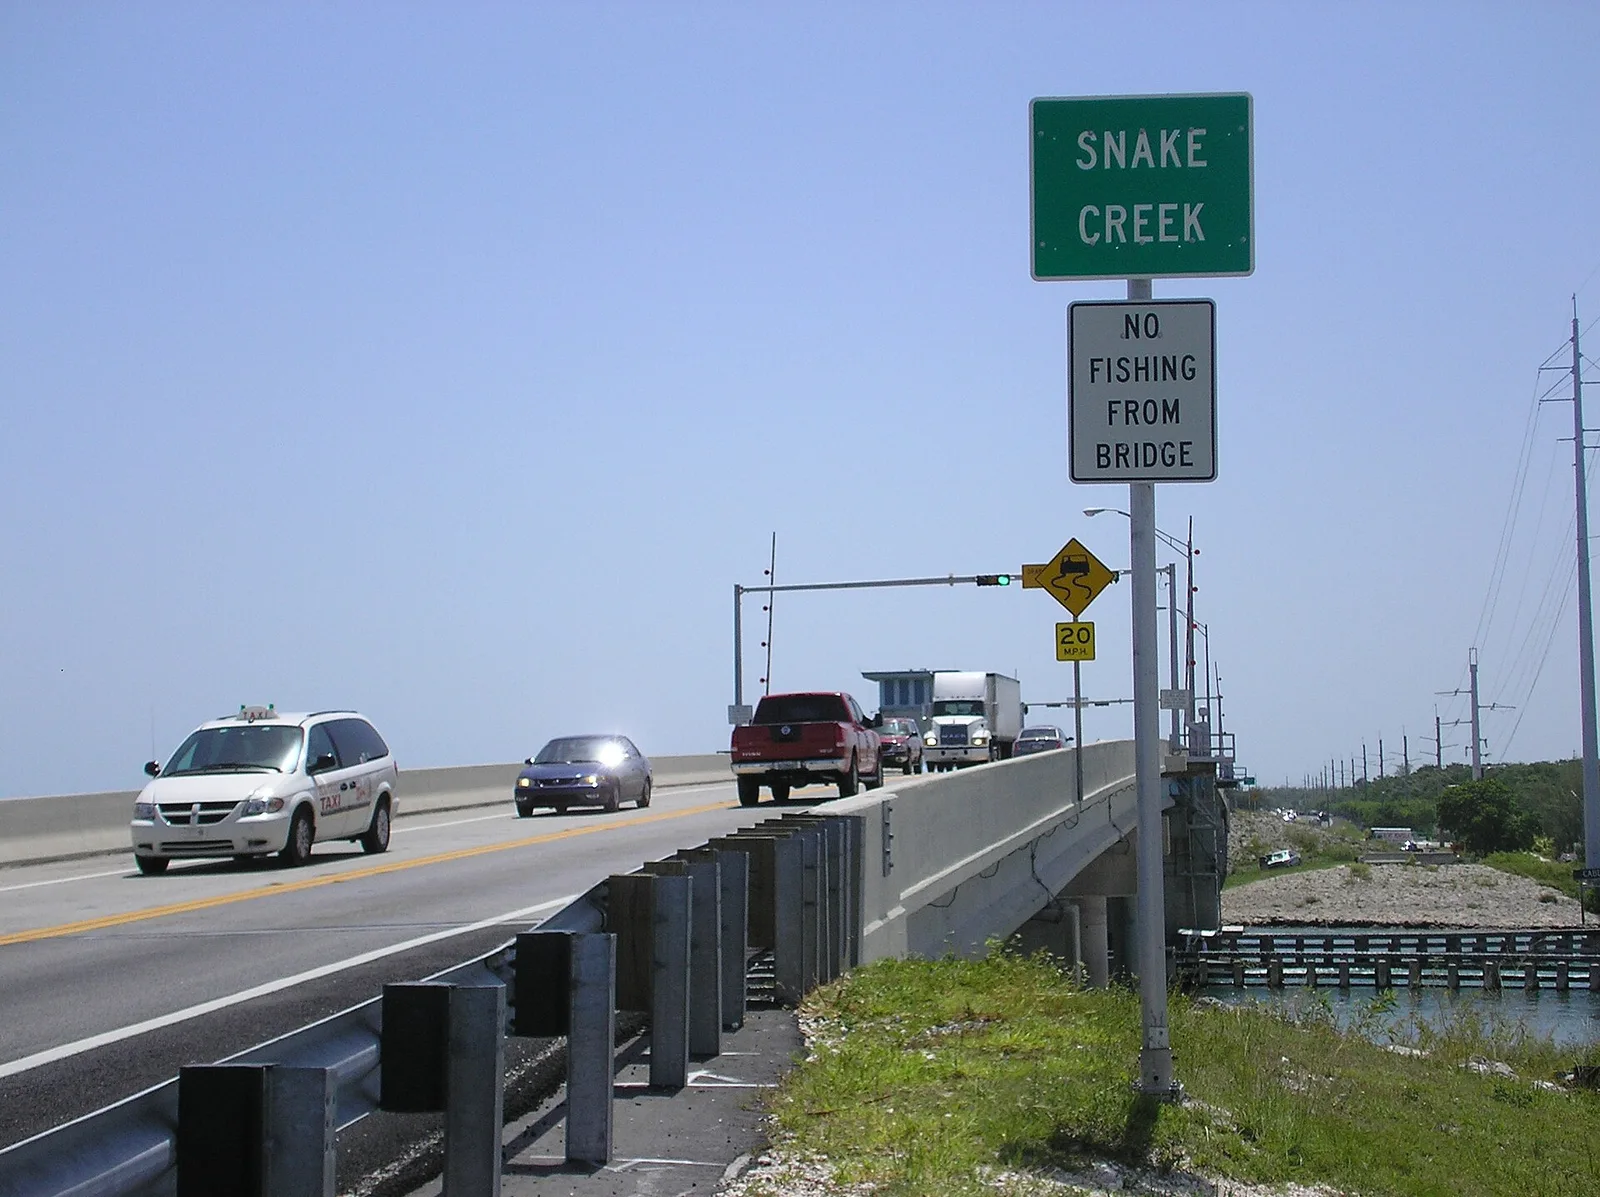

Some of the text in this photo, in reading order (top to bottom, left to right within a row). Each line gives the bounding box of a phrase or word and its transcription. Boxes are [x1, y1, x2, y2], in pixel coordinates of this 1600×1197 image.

[1075, 128, 1208, 170] SNAKE
[1078, 203, 1206, 245] CREEK
[1125, 313, 1159, 339] NO
[1090, 355, 1196, 383] FISHING
[1108, 399, 1180, 425] FROM
[1096, 441, 1194, 469] BRIDGE
[1061, 627, 1091, 645] 20
[243, 711, 268, 719] TAXI
[320, 794, 341, 811] TAXI
